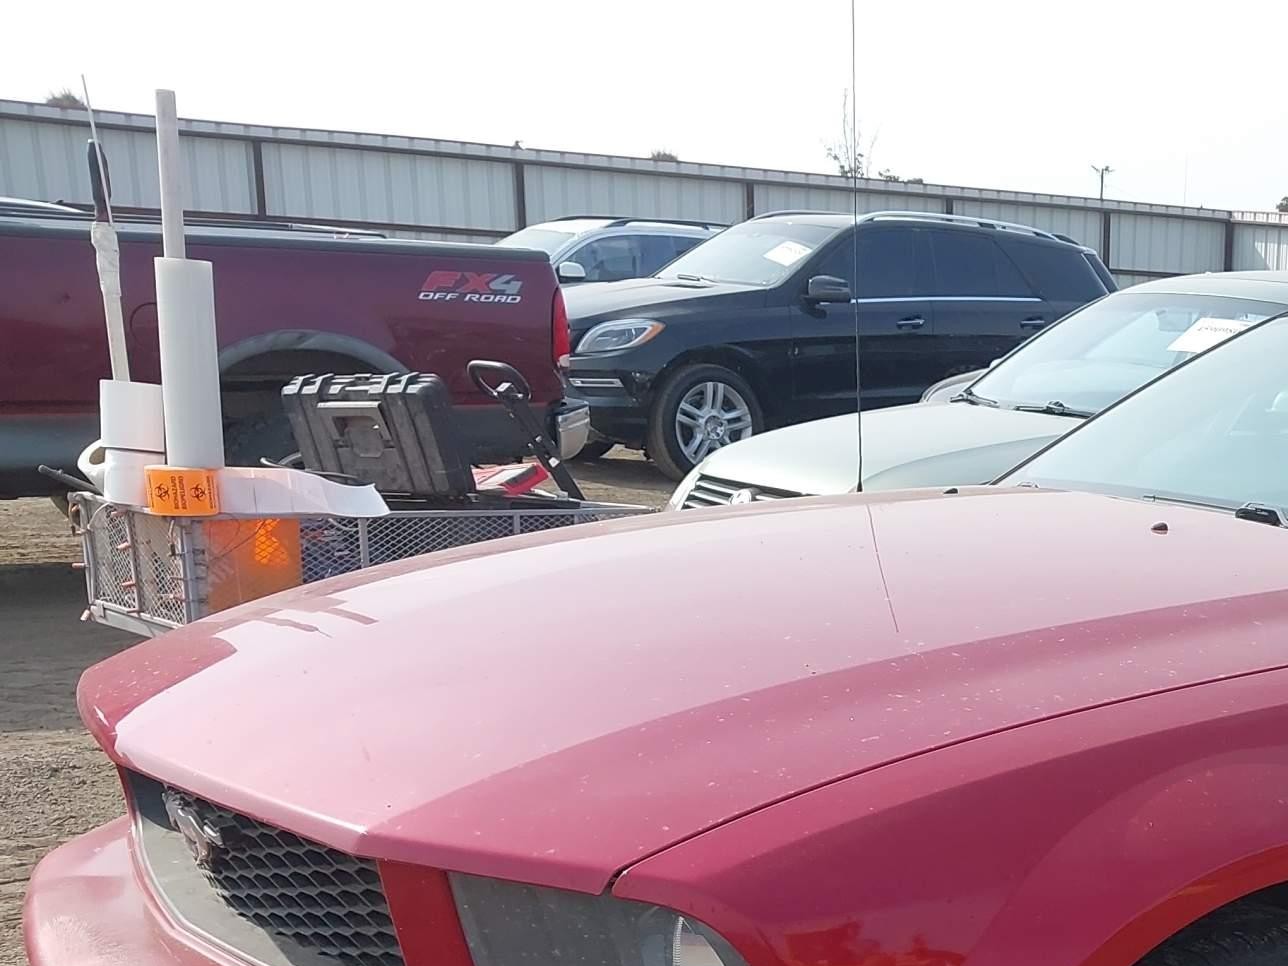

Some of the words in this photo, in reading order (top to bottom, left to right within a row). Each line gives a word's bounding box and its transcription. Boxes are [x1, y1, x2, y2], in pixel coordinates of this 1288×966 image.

[421, 270, 523, 294] FX4
[417, 291, 460, 301] OFF
[464, 293, 522, 304] ROAD
